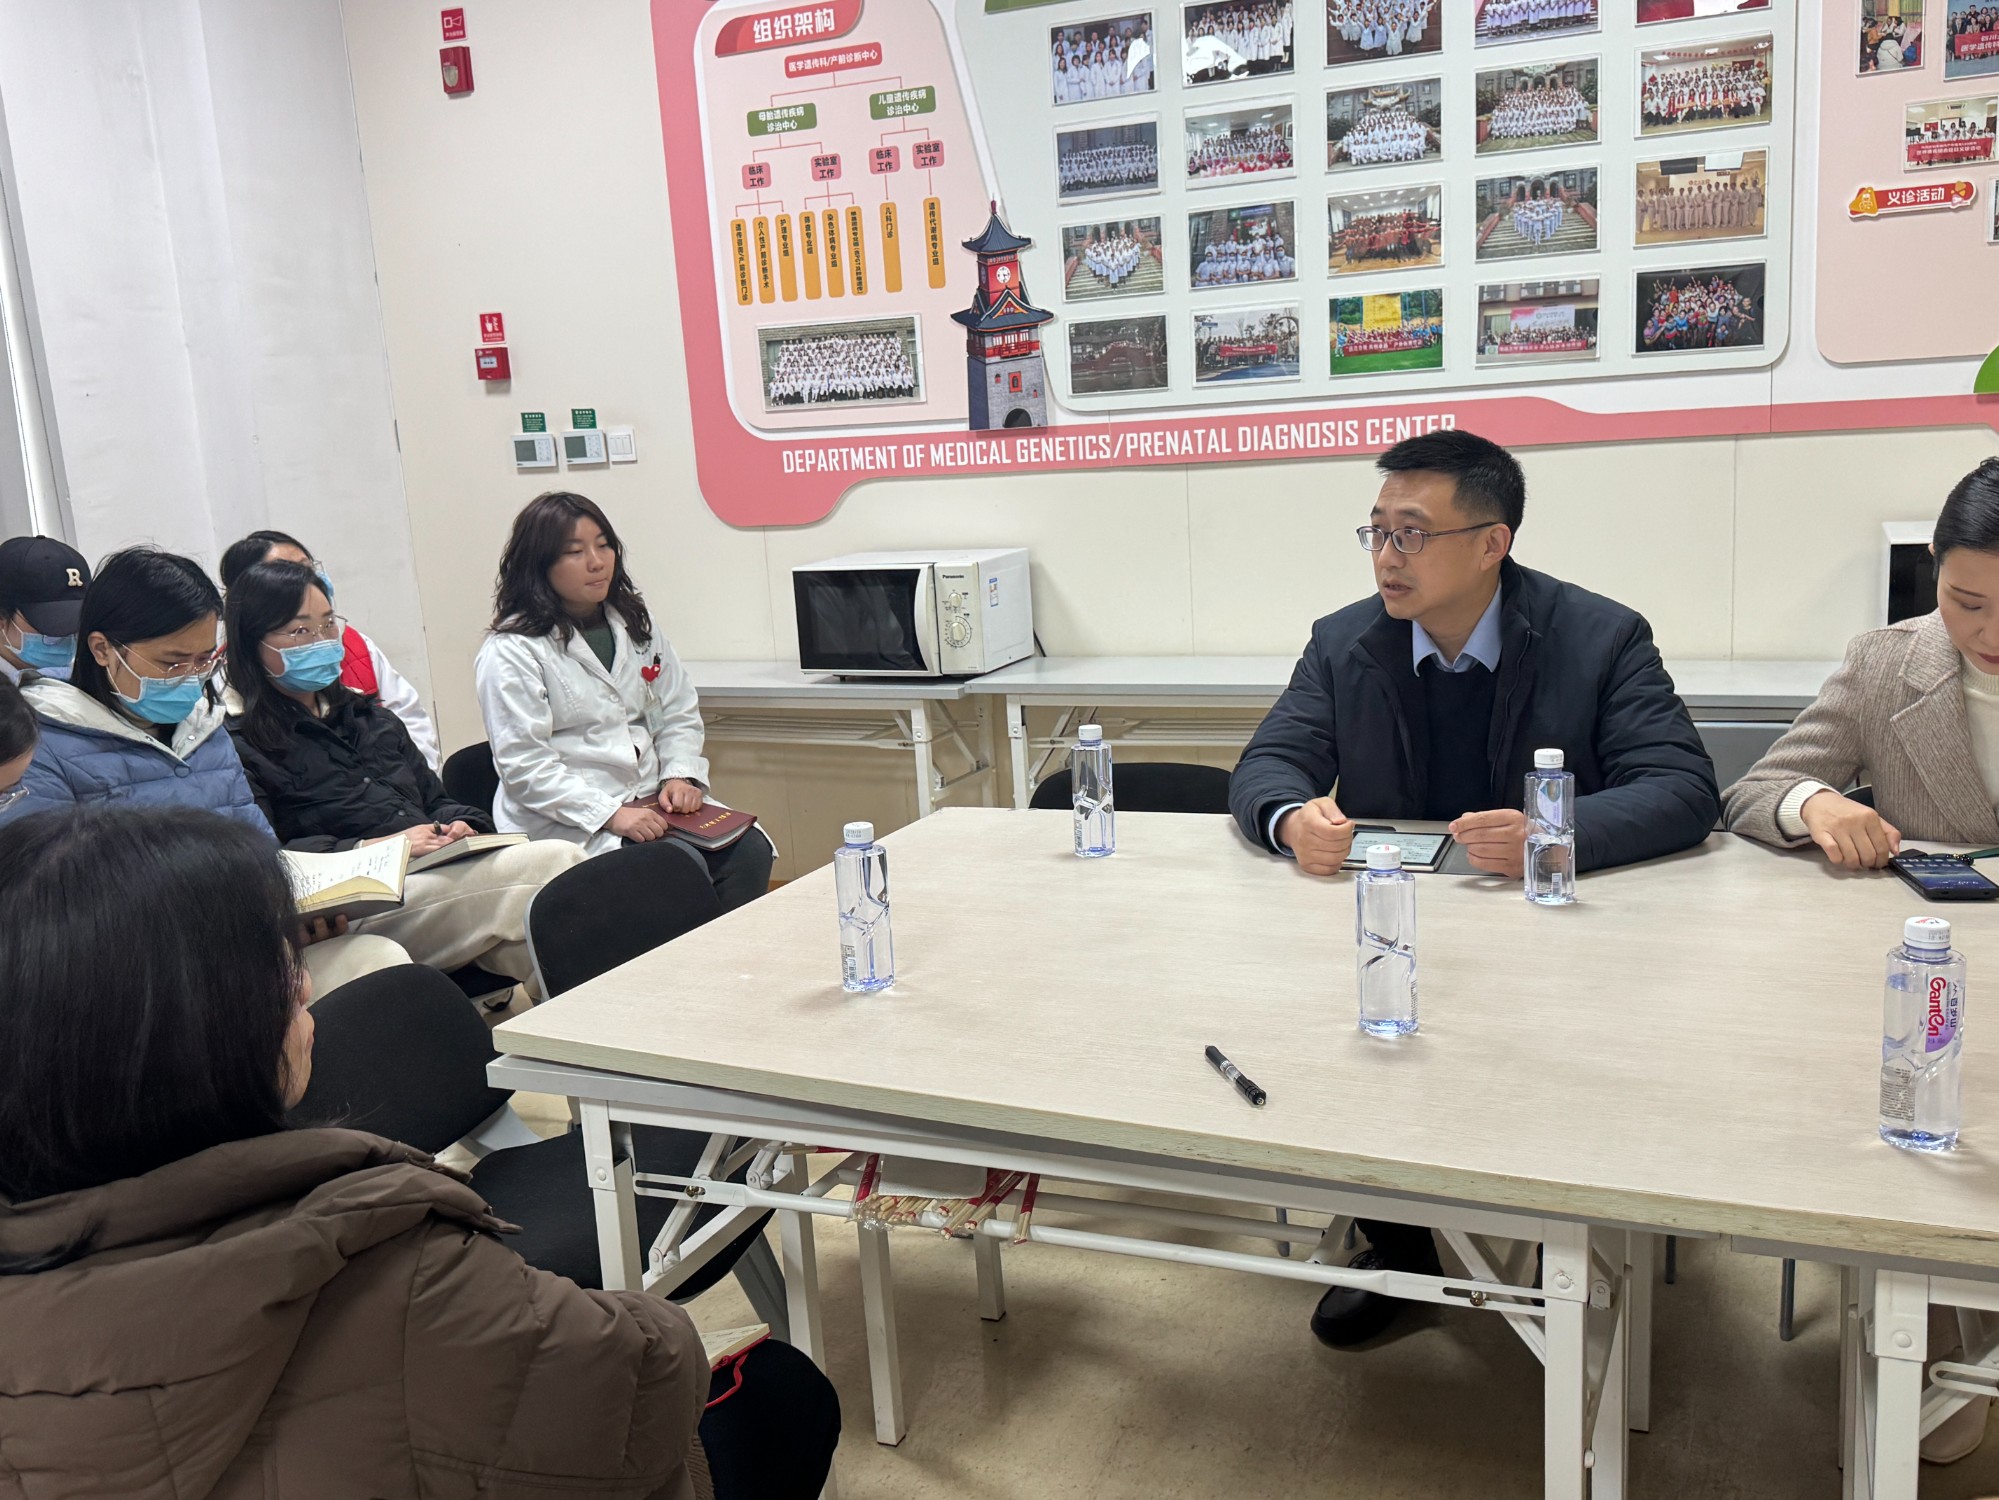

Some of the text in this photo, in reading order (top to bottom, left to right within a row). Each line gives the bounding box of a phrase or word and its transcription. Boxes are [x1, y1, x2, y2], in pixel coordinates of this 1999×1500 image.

[753, 8, 835, 44] 组织架构
[788, 49, 879, 72] 医学遗传科/产前诊断中心
[878, 90, 927, 105] 儿童遗传疾病
[758, 106, 804, 122] 母胎遗传疾病
[886, 103, 919, 116] 诊治中心
[767, 119, 798, 132] 诊治中心
[876, 149, 893, 160] 临床
[915, 143, 940, 155] 实验室
[814, 156, 838, 167] 实验室
[877, 161, 893, 171] 工作
[921, 155, 937, 166] 工作
[748, 165, 764, 175] 临床
[819, 168, 835, 179] 工作
[750, 177, 765, 187] 工作
[1887, 187, 1945, 205] 义诊活动
[885, 207, 894, 239] 儿科门诊
[780, 218, 789, 257] 护理专业组
[827, 213, 838, 267] 染色体病专业组
[928, 202, 939, 266] 遗传代谢病专业组
[757, 221, 769, 288] 介入性产前诊断手术
[782, 414, 1455, 473] DEPARTMENT OF MEDICAL GENETICS/PRENATAL DIAGNOSIS CENTER
[66, 568, 84, 587] R
